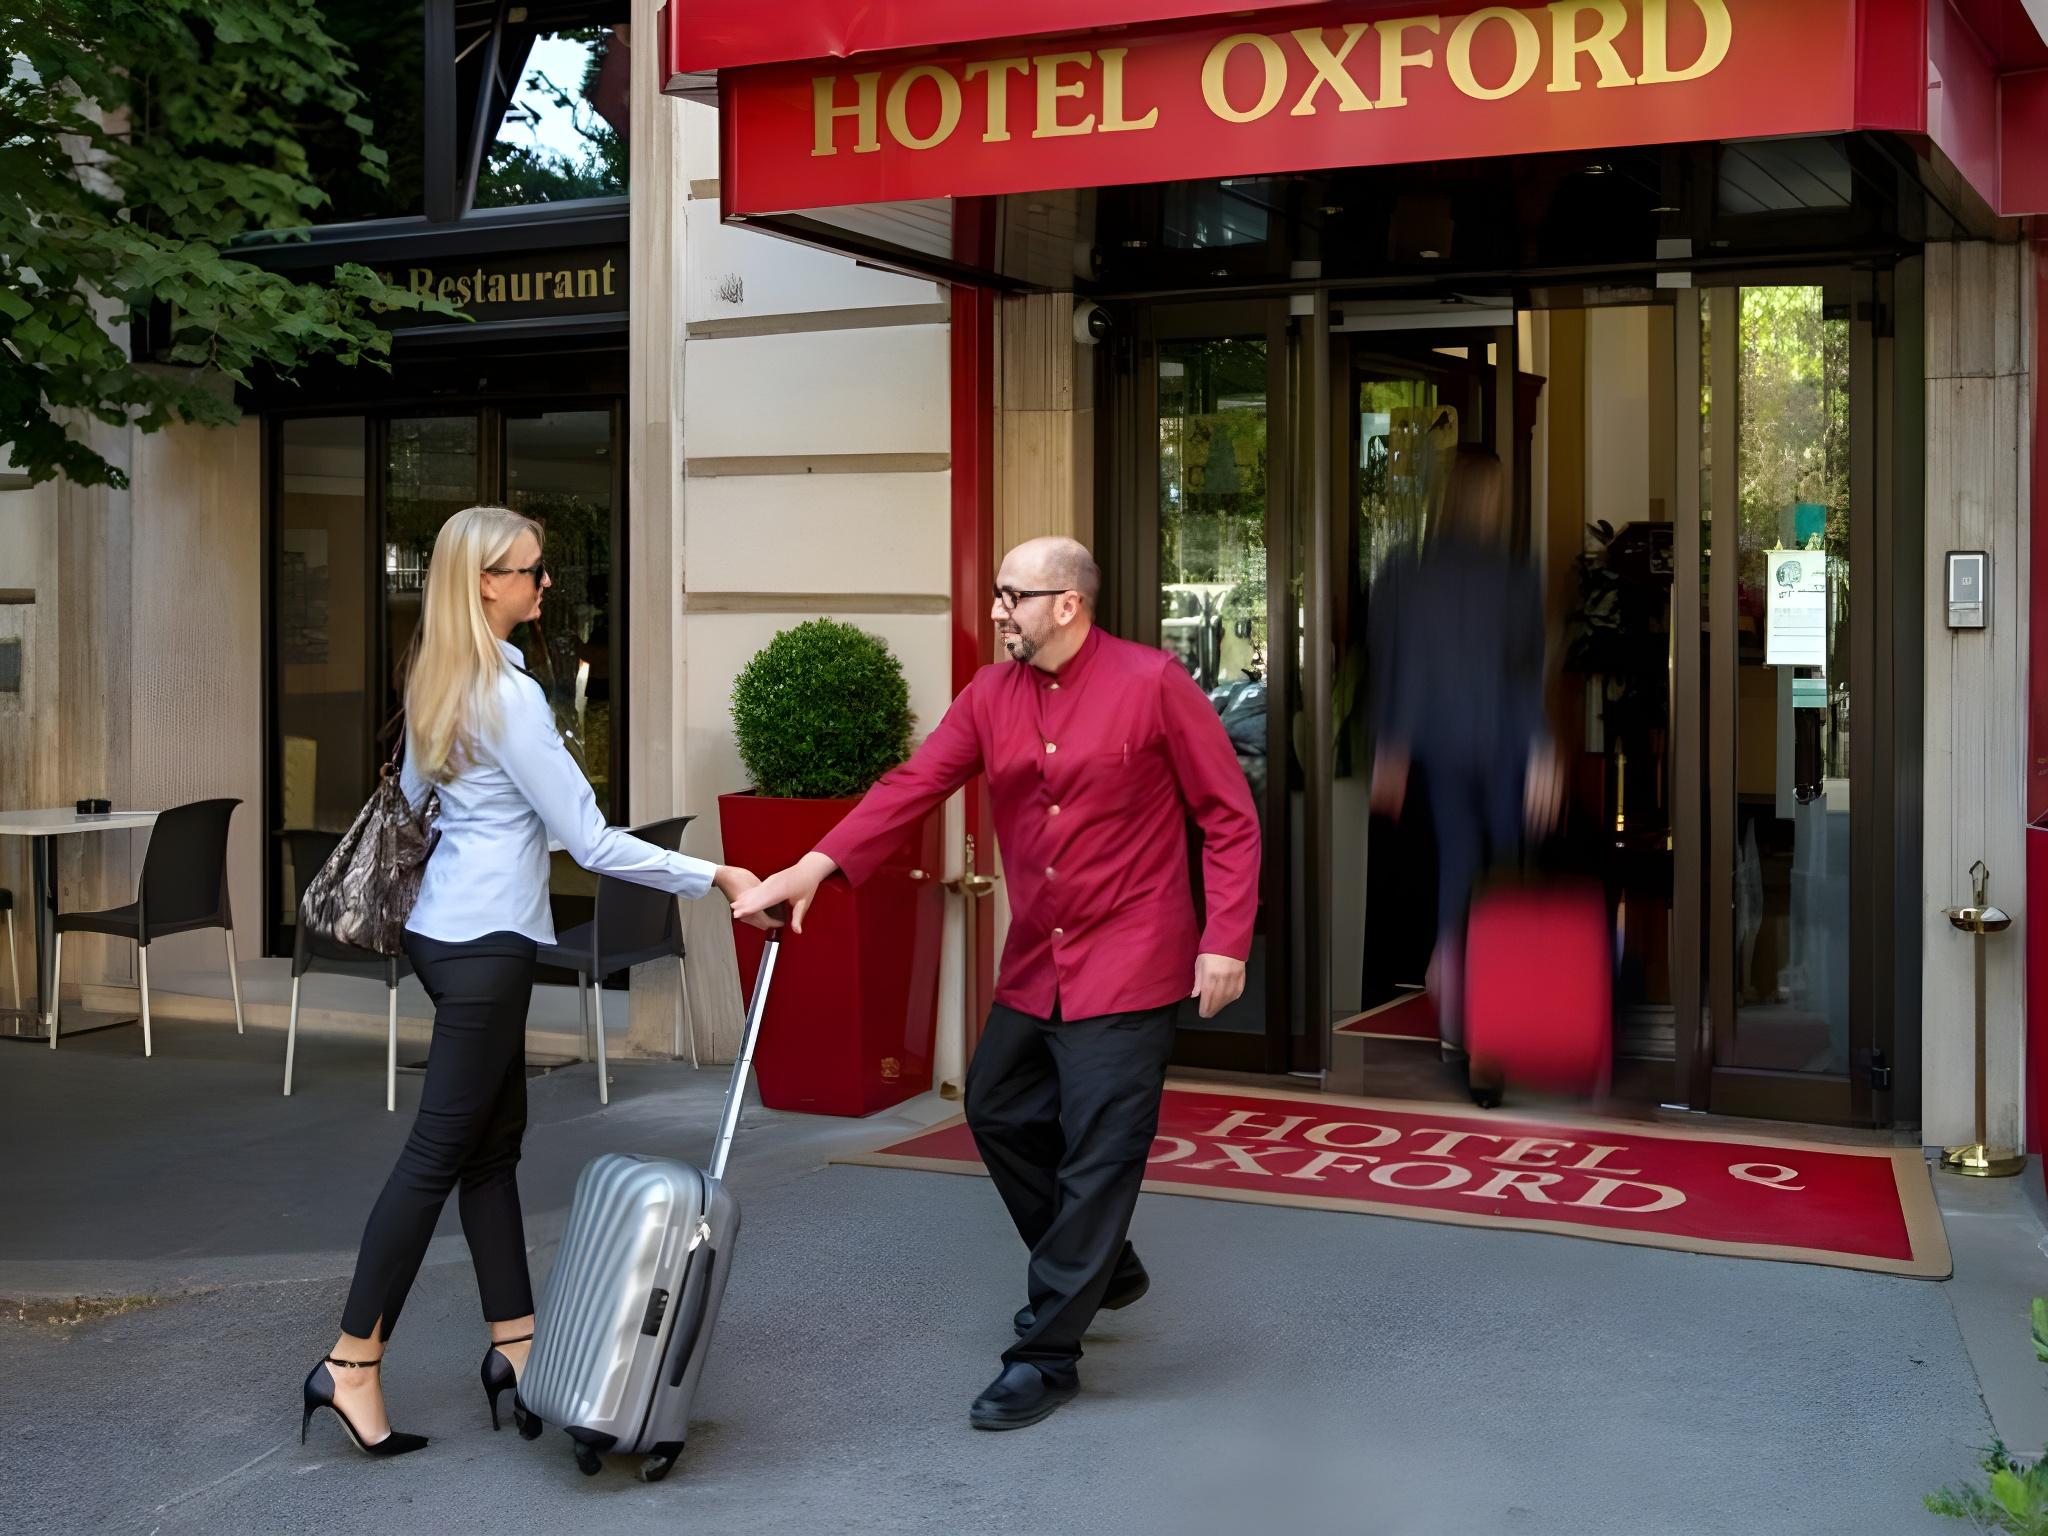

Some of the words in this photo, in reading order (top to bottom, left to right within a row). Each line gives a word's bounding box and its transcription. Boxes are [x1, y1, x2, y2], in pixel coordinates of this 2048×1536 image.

[811, 47, 1158, 156] HOTEL
[1201, 0, 1732, 123] OXFORD
[408, 259, 615, 306] Restaurant
[1193, 1109, 1642, 1175] HOTEL
